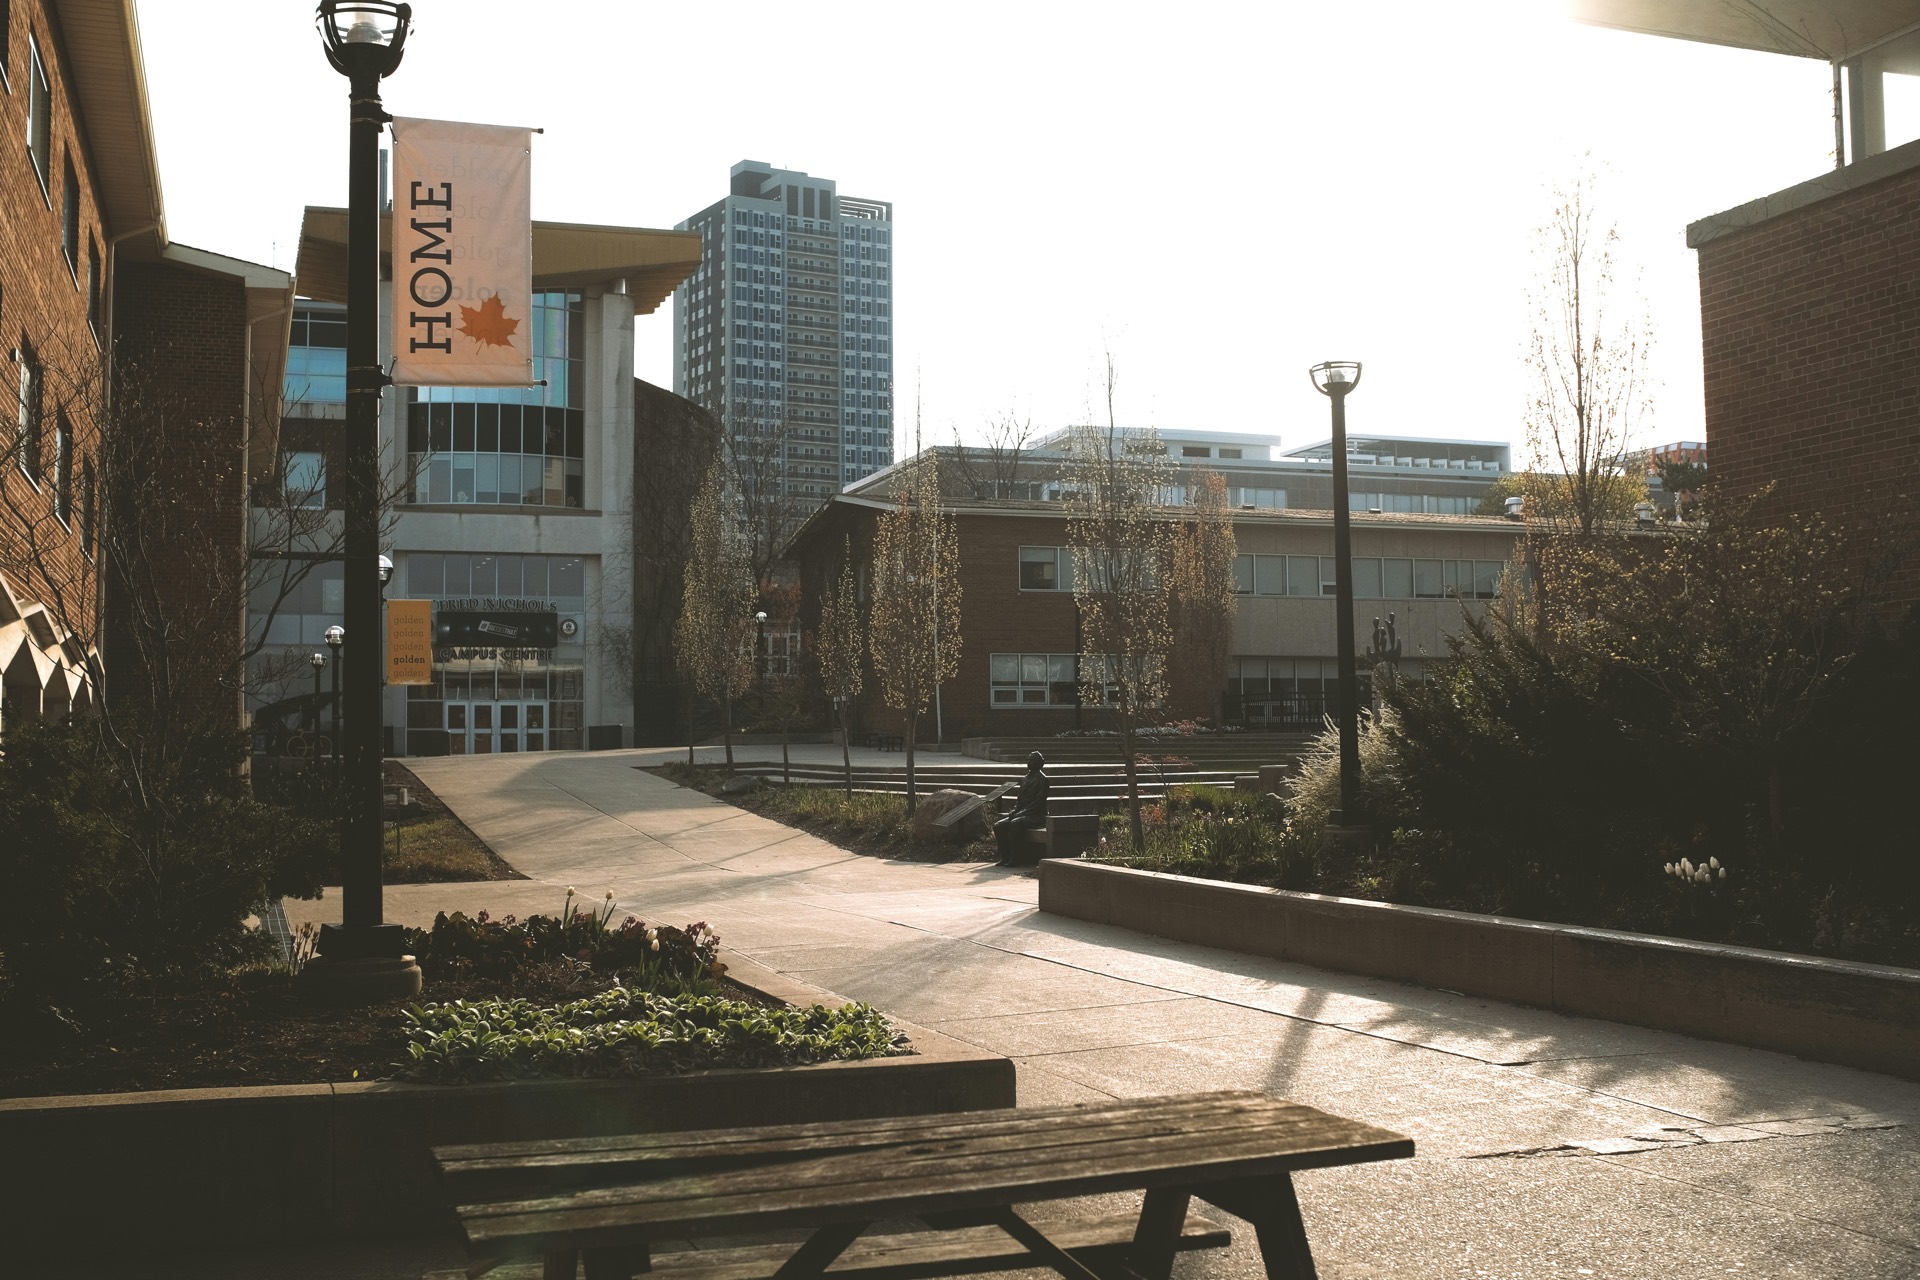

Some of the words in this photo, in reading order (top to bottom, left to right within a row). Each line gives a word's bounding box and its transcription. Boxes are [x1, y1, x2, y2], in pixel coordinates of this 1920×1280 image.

[410, 181, 452, 354] HOME
[439, 598, 479, 610] FRED
[483, 598, 558, 612] NICHOLS
[393, 615, 424, 625] golden
[393, 628, 424, 639] golden
[393, 641, 424, 652] golden
[393, 655, 426, 665] golden
[440, 649, 497, 661] CAMPUS
[502, 649, 554, 661] CENTRE
[393, 668, 424, 678] golden
